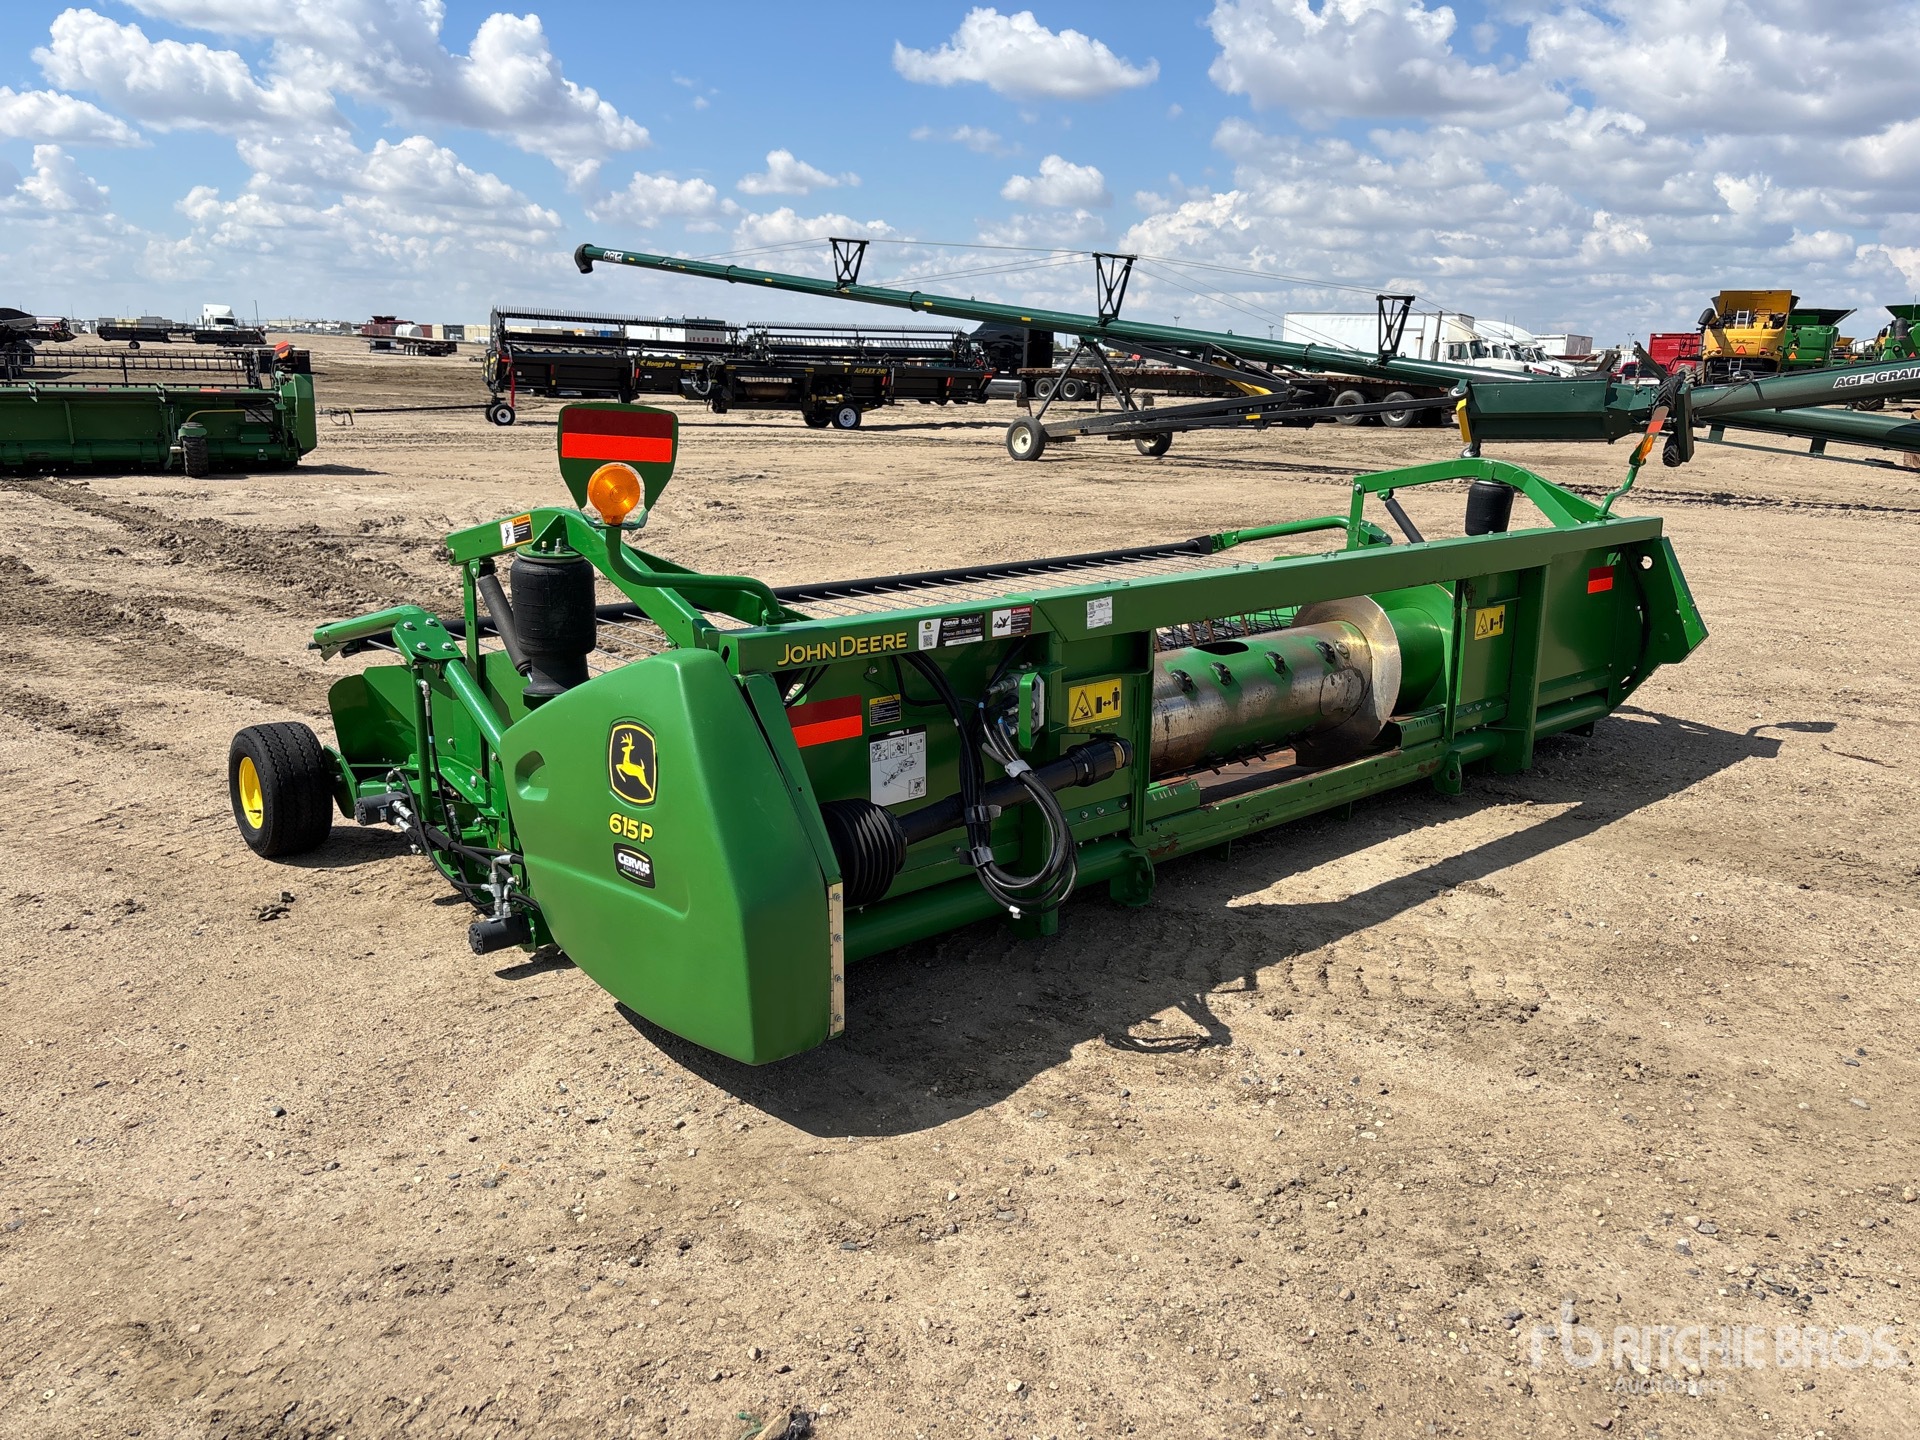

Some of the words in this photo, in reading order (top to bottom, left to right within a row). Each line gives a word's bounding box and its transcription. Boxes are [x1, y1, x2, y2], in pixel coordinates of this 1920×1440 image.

[1833, 375, 1862, 388] AGI
[777, 641, 837, 666] JOHN
[839, 632, 908, 658] DEERE
[609, 812, 654, 844] 615P
[617, 852, 651, 875] CERVUS
[623, 865, 647, 878] EQUIPMENT
